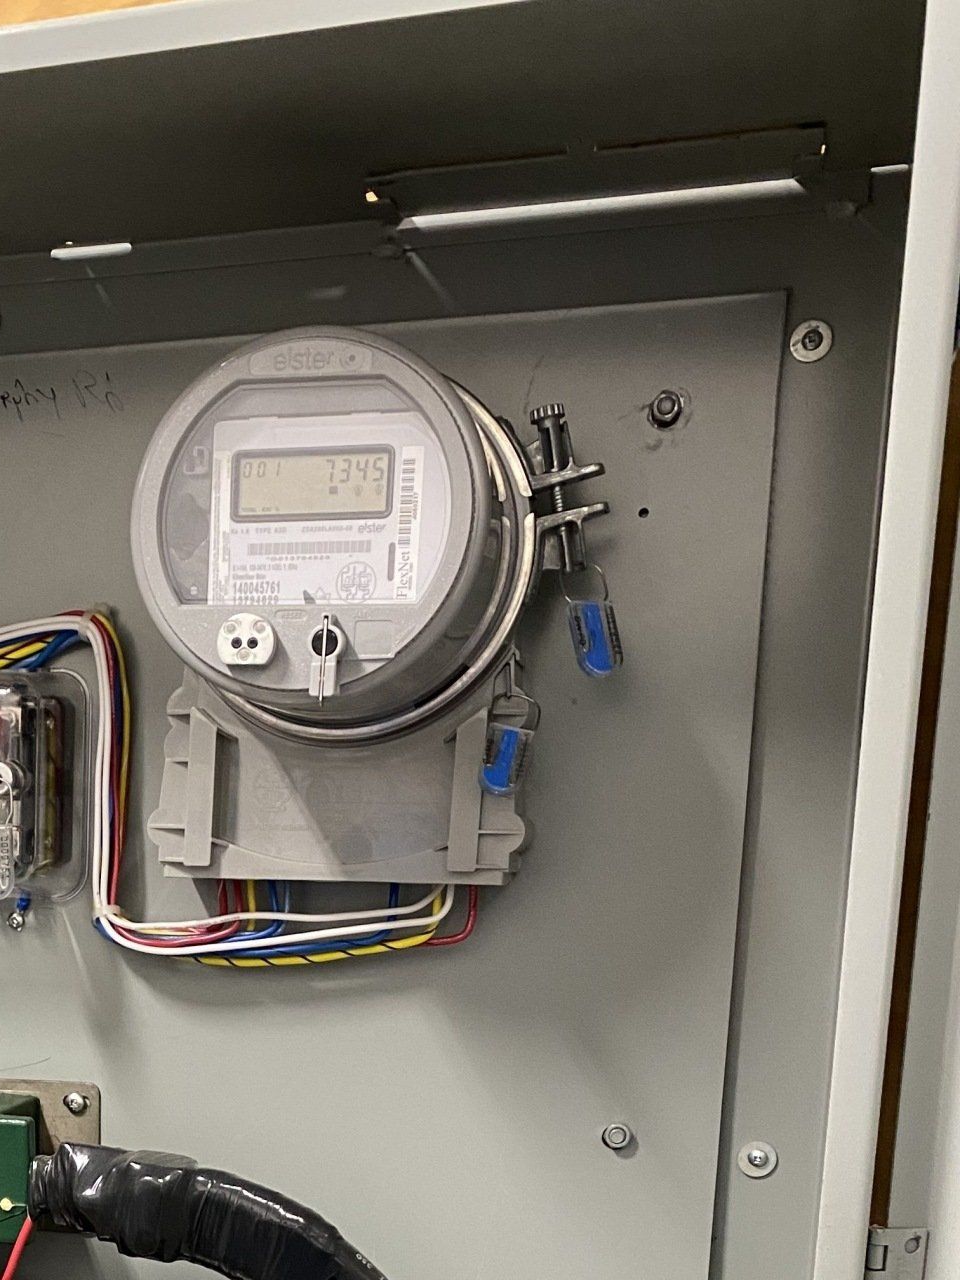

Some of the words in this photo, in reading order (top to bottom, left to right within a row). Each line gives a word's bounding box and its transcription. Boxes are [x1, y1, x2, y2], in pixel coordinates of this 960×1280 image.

[273, 346, 334, 371] elster
[326, 457, 385, 483] 7345
[358, 522, 387, 534] elster
[396, 551, 410, 600] FlexNet
